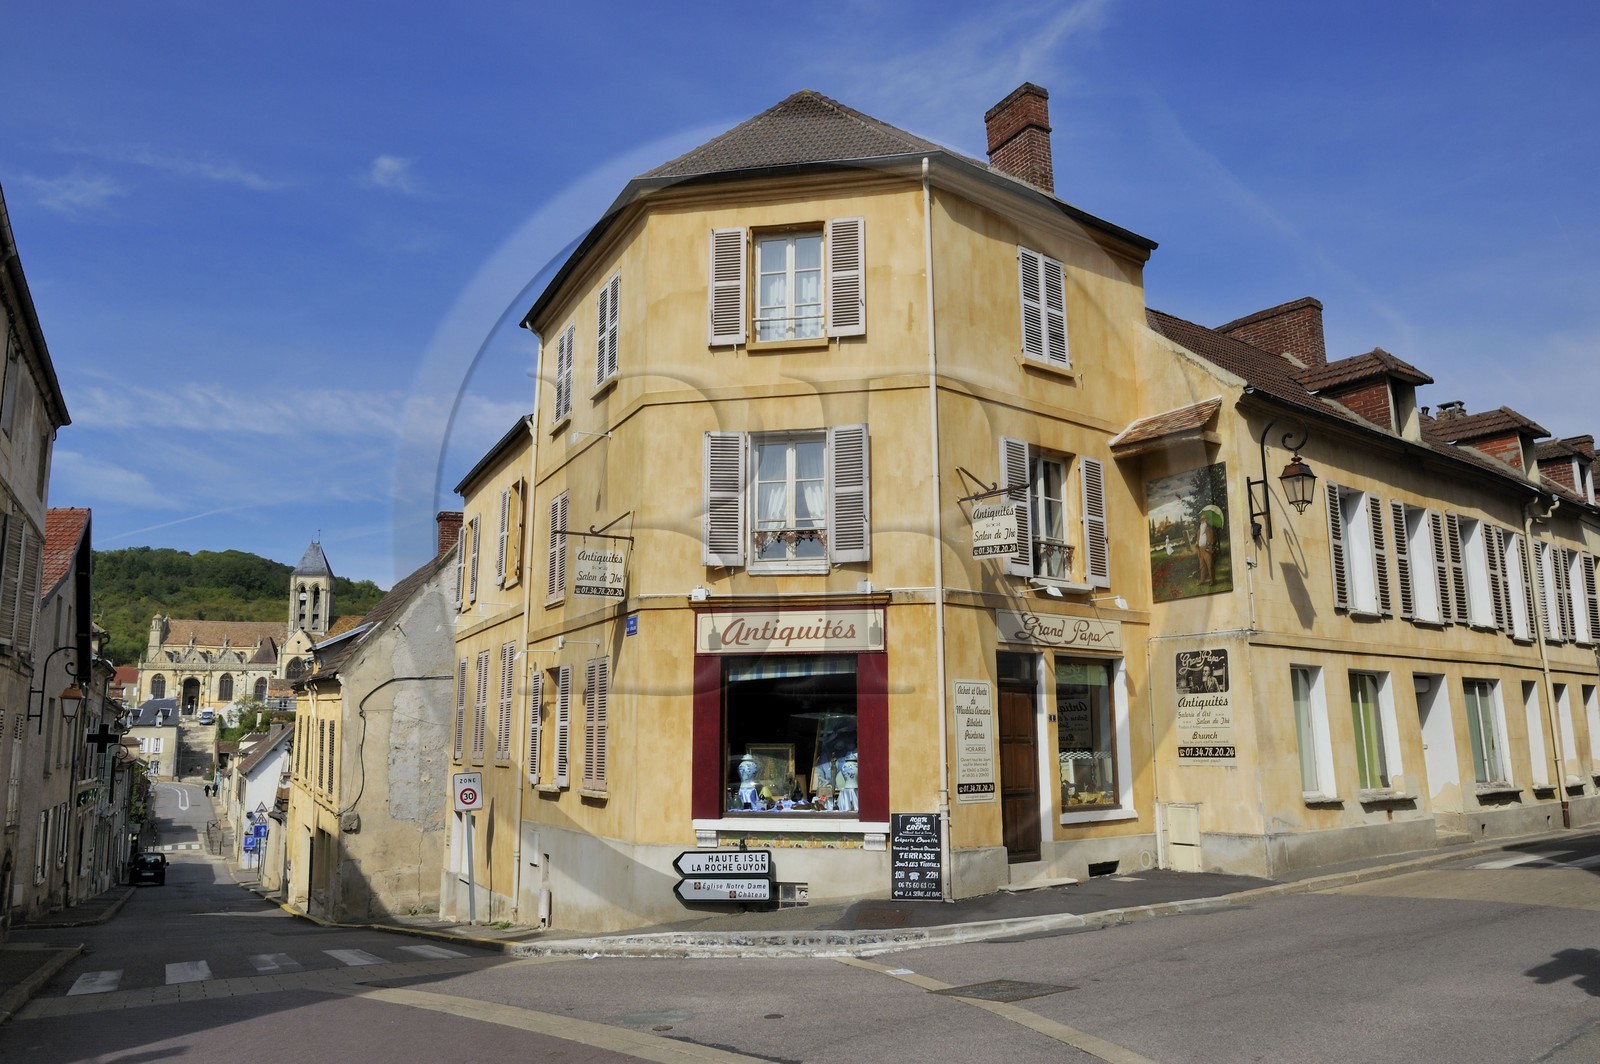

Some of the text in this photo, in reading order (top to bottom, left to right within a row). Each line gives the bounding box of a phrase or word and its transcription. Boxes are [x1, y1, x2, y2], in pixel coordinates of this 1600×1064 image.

[973, 506, 1014, 520] Antiquités
[974, 528, 1016, 542] Salon de Thé
[578, 551, 623, 565] Antiquités
[577, 571, 622, 584] Salon de Thé
[721, 618, 856, 647] Antiquités
[1015, 613, 1114, 645] Grand Papa
[1179, 650, 1224, 675] Grand Papa
[1178, 696, 1228, 709] Antiquités
[1192, 732, 1218, 740] Brunch
[1186, 748, 1234, 757] 01.34.78.20.24
[744, 854, 766, 862] ISLE
[692, 864, 701, 872] LA
